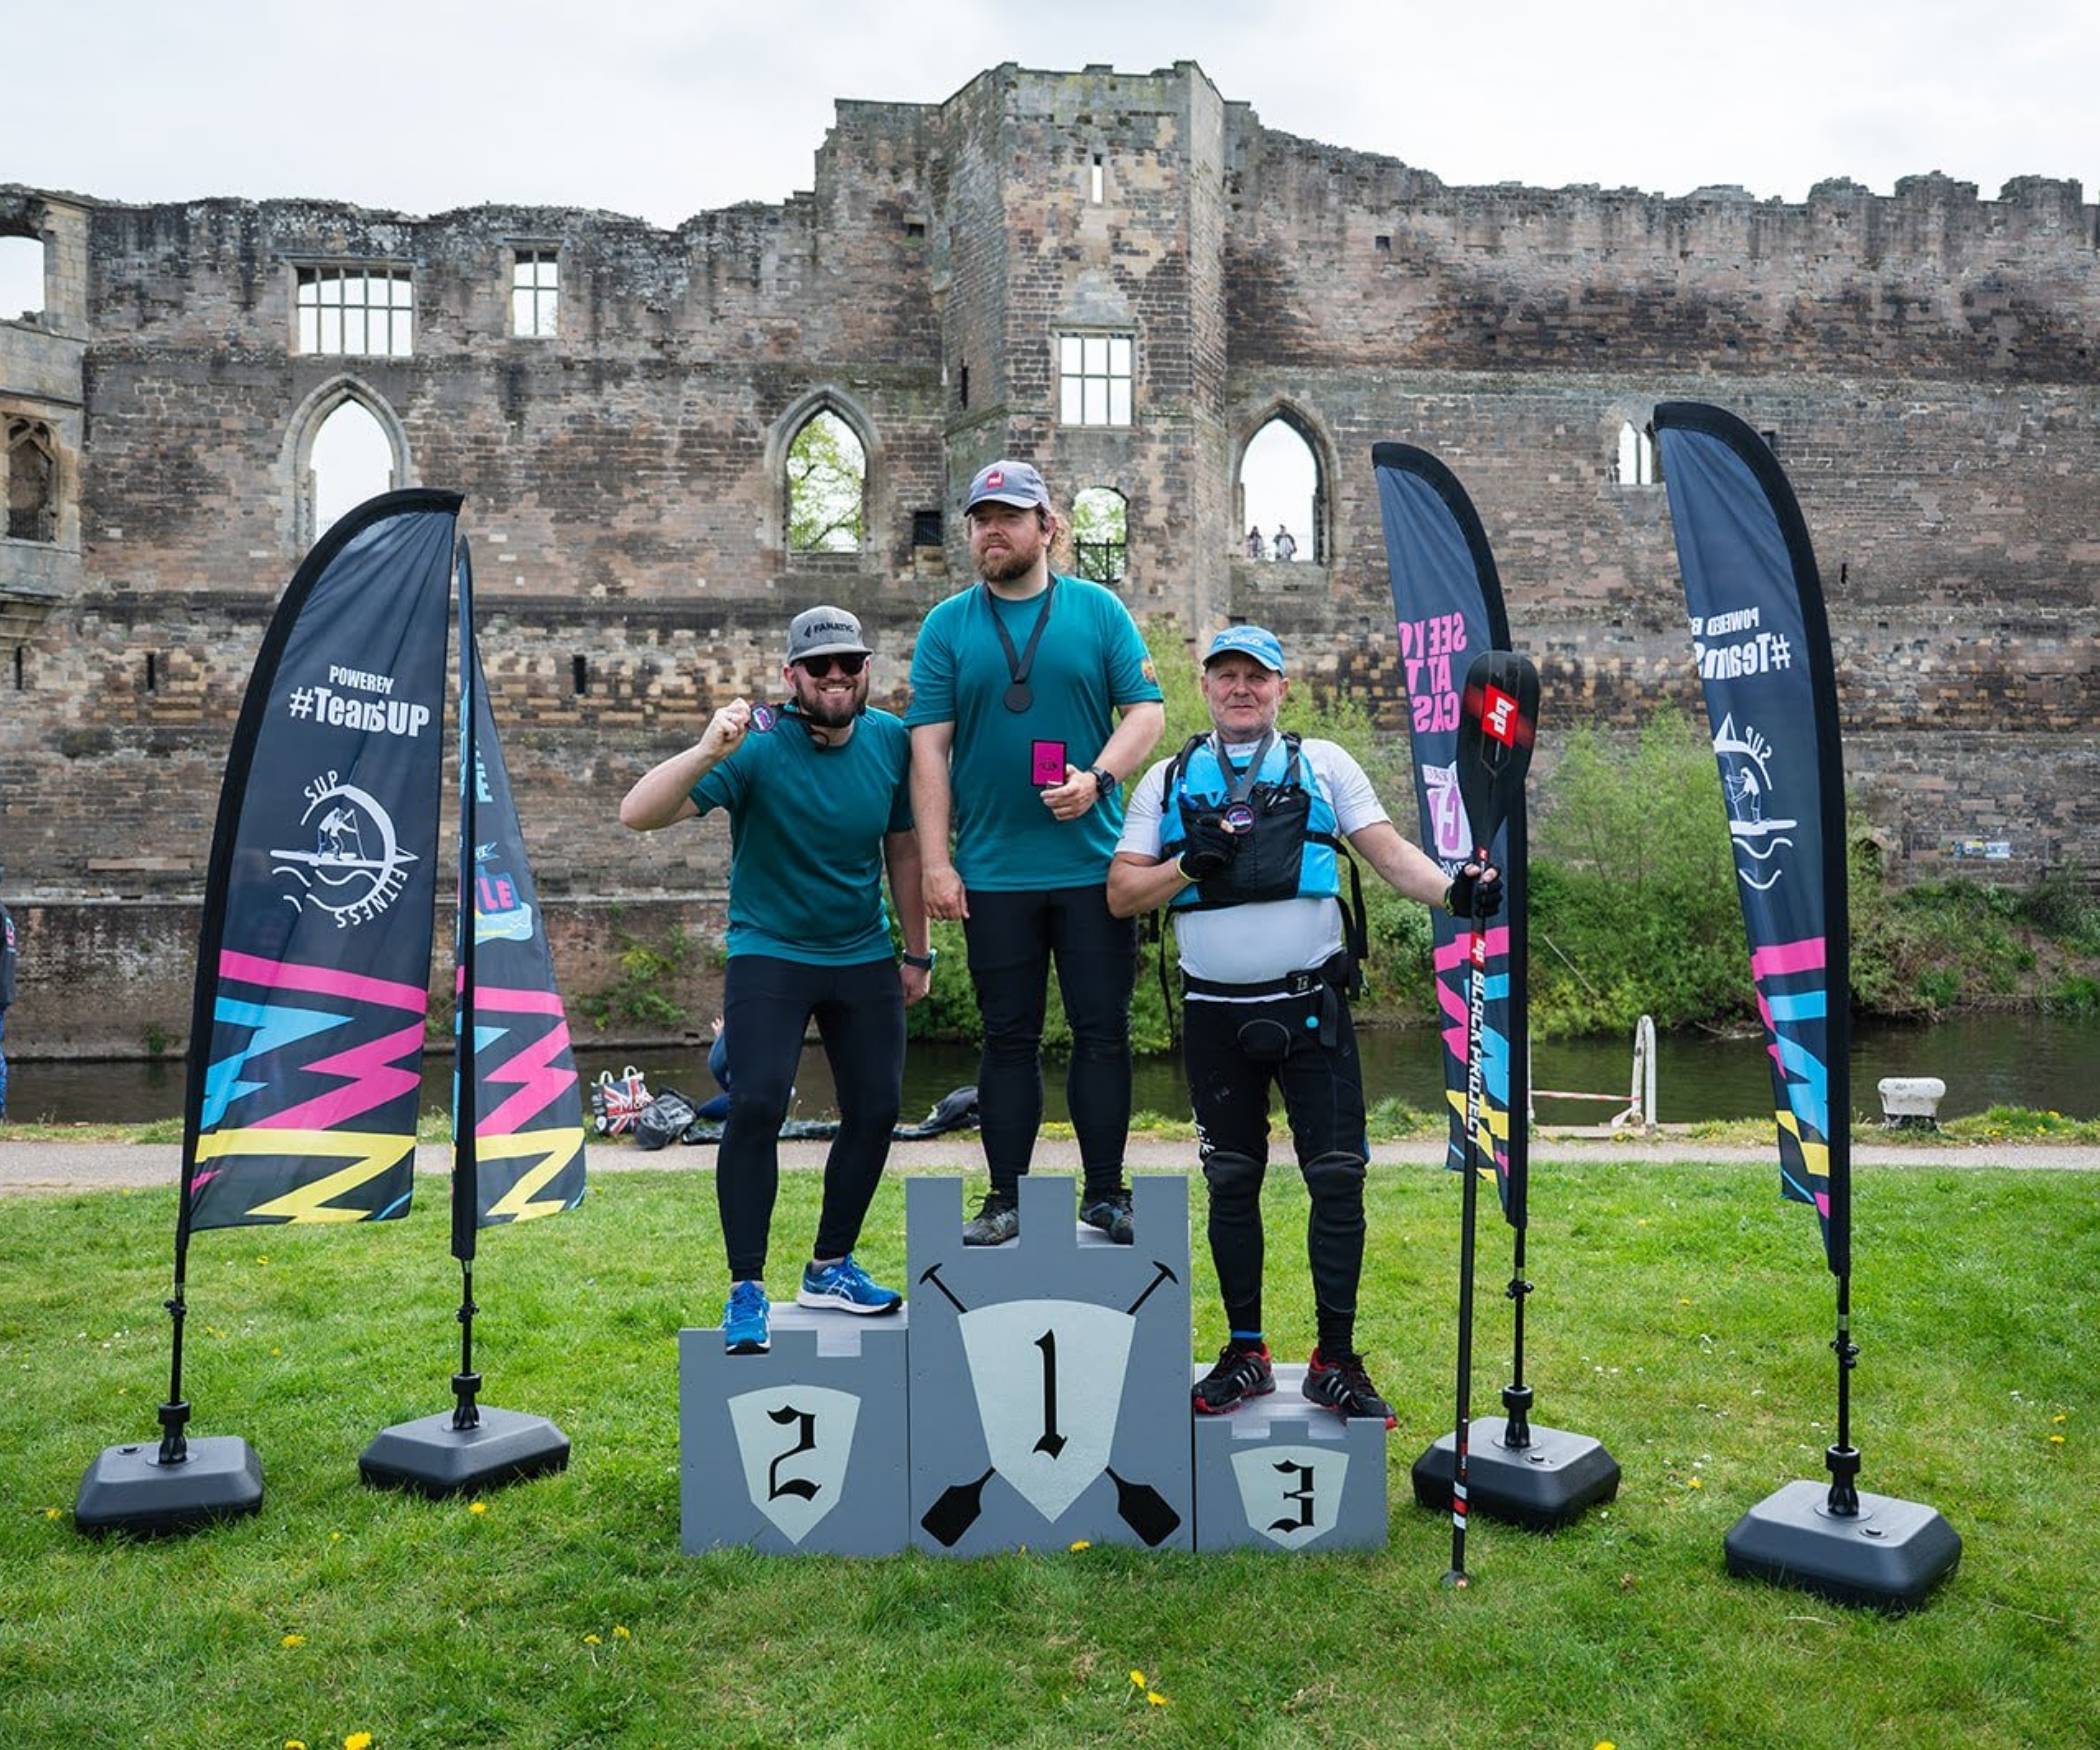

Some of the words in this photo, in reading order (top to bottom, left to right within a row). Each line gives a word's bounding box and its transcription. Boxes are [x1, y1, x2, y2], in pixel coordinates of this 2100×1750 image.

[304, 770, 339, 801] SUP
[336, 868, 409, 928] FITNESS
[1469, 969, 1485, 1043] BLACK
[1467, 1044, 1482, 1142] PROJECT
[1031, 1329, 1068, 1460] 1
[767, 1405, 821, 1502] 2
[1268, 1459, 1314, 1533] 3
